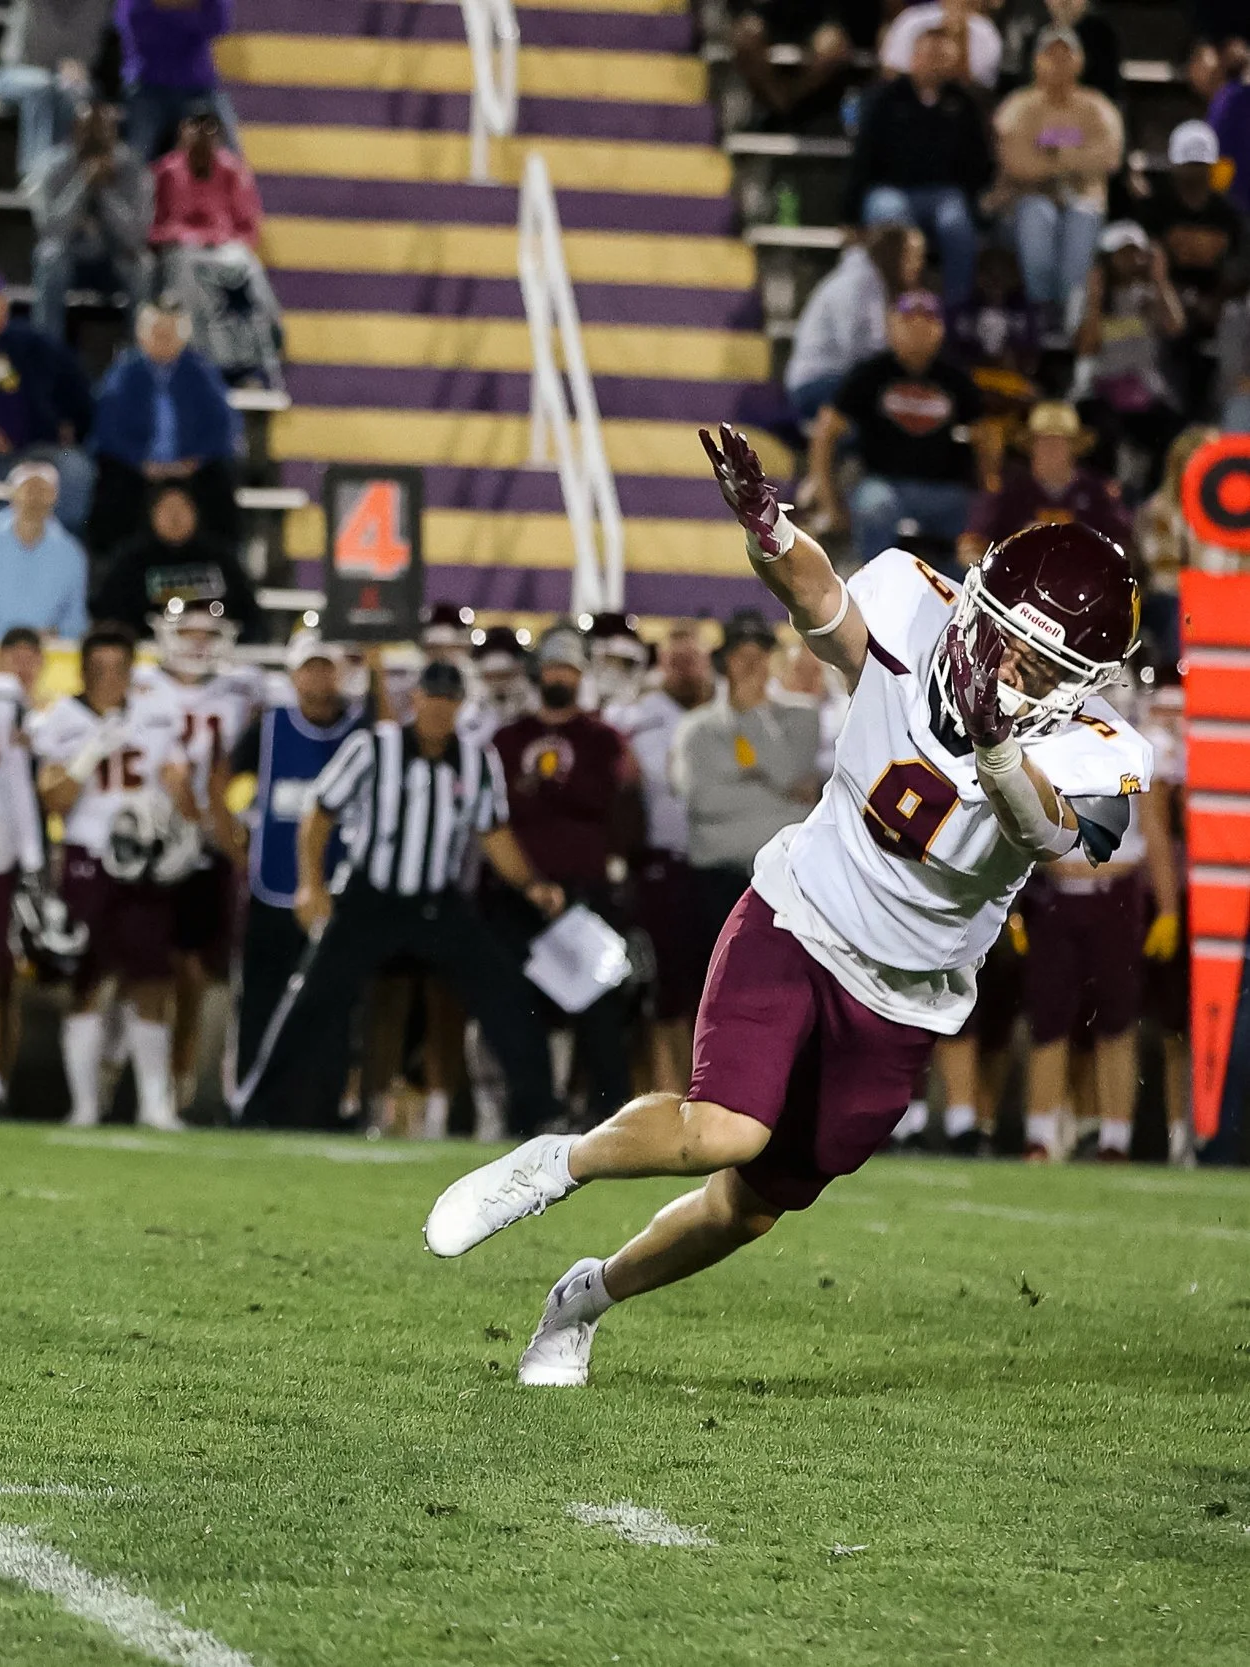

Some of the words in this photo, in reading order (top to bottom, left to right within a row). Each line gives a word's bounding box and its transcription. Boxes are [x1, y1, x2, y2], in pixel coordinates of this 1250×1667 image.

[334, 480, 412, 576] 4
[1019, 606, 1061, 638] Riddell
[862, 757, 962, 864] 9
